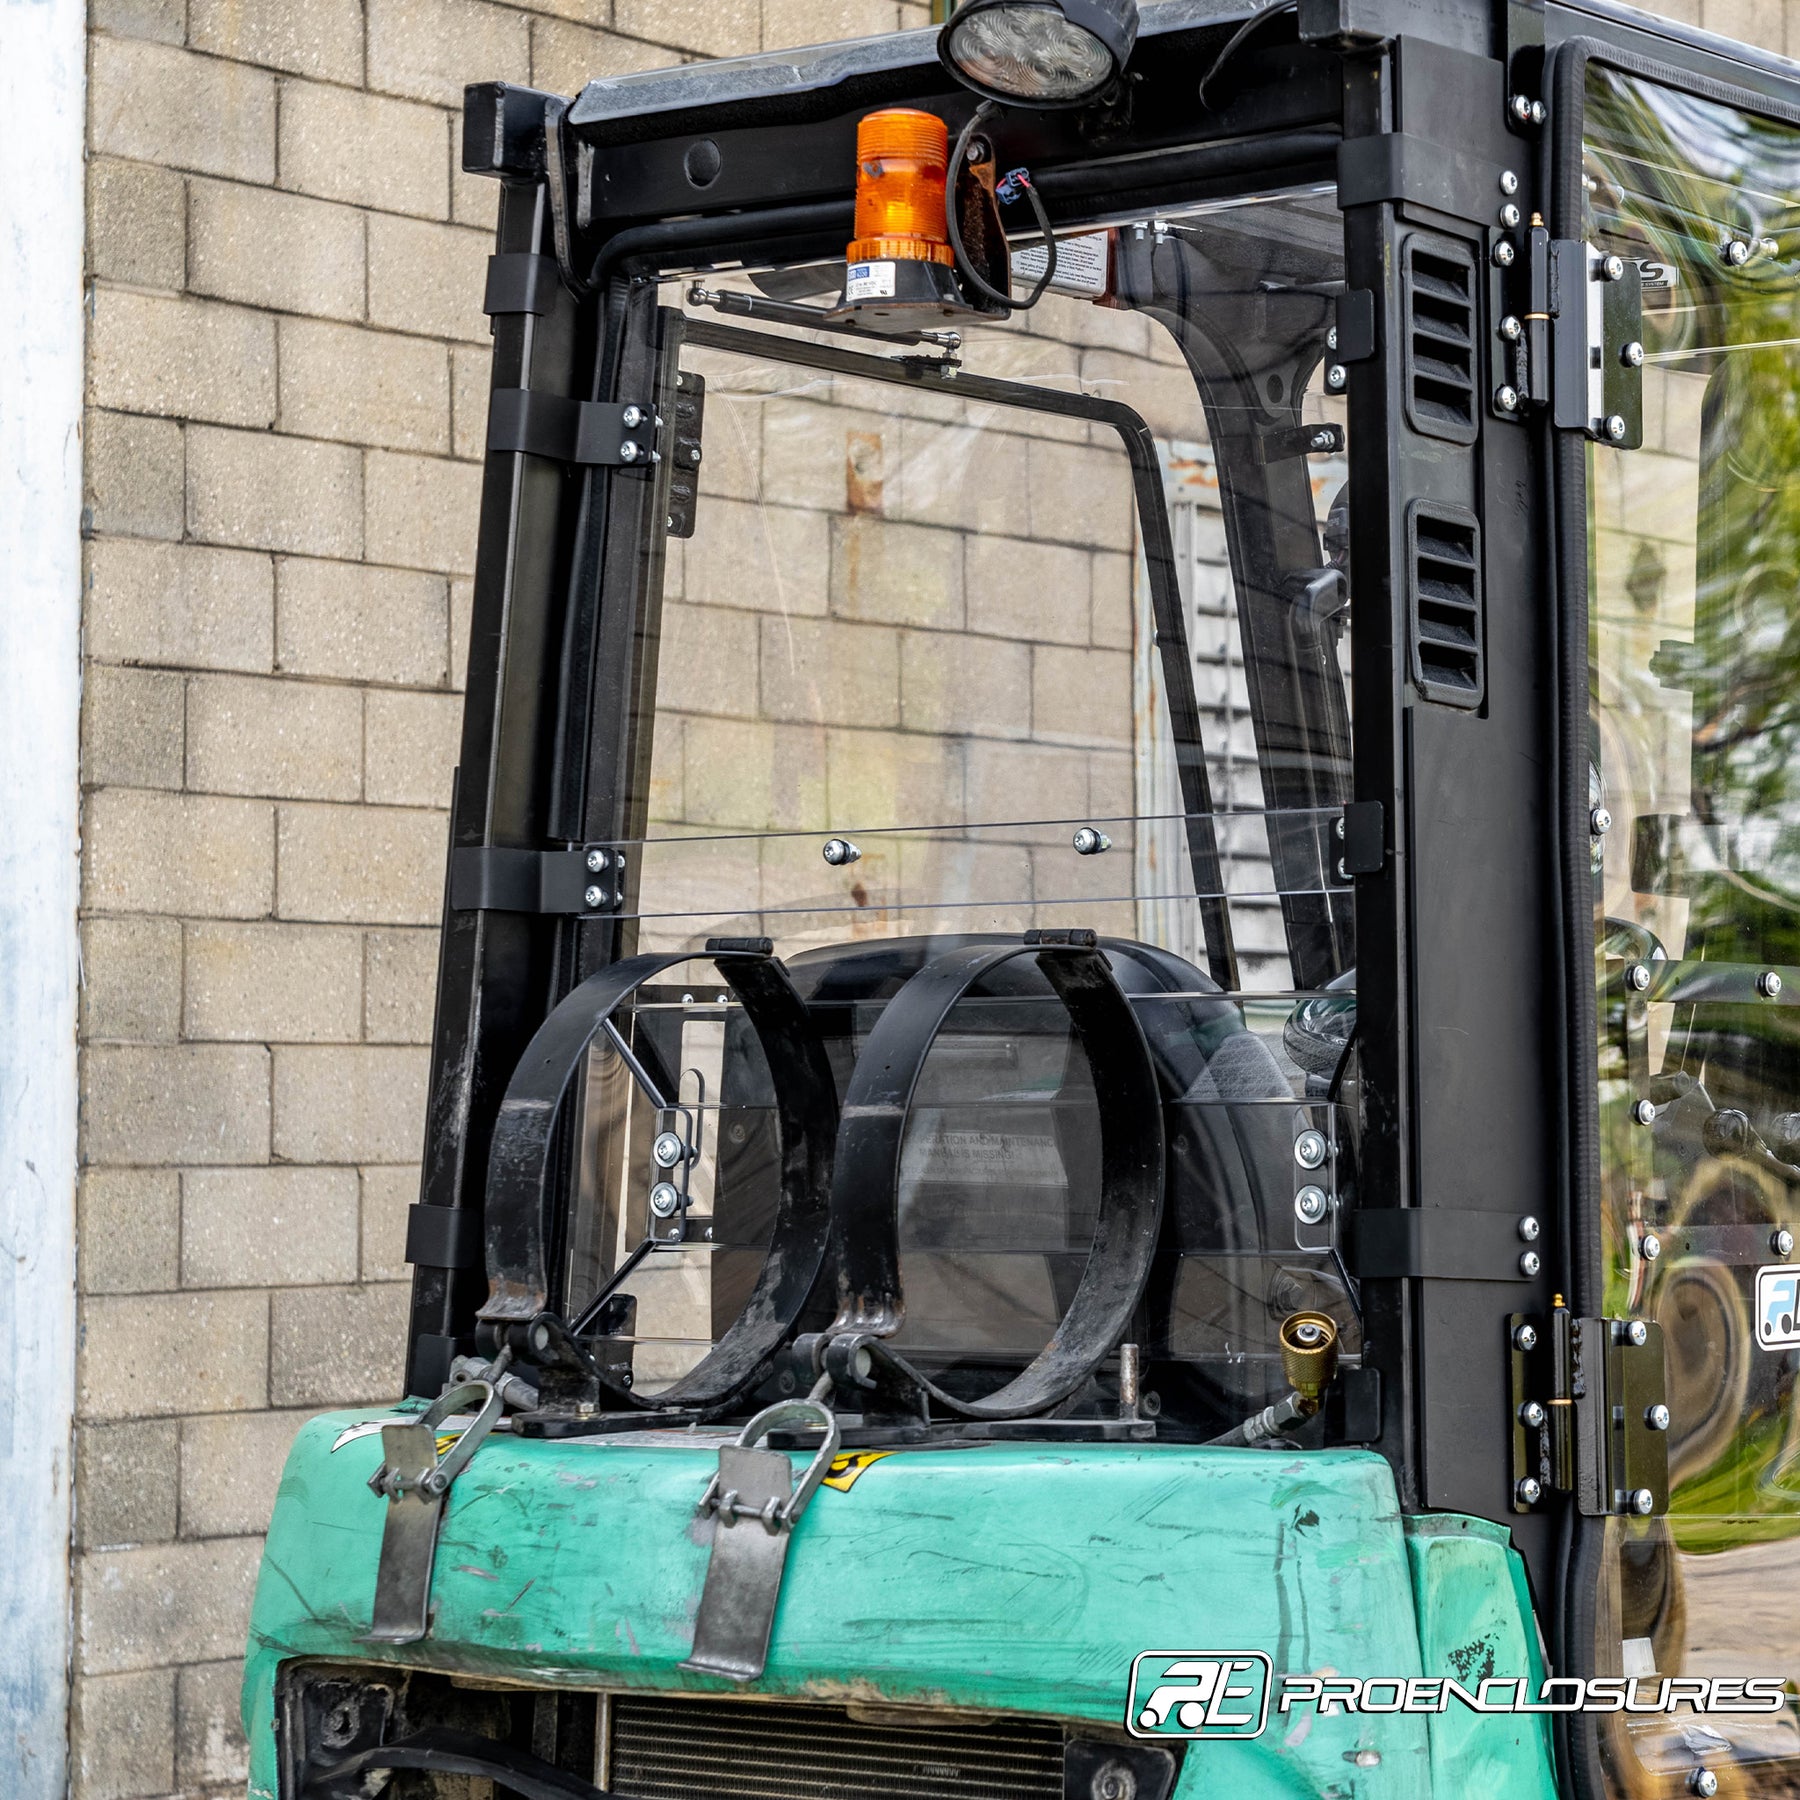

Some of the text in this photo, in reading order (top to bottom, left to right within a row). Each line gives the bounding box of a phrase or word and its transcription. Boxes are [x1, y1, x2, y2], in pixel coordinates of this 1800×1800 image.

[1639, 260, 1664, 281] S
[914, 1134, 967, 1146] PERATION
[991, 1134, 1055, 1148] MAINTENANC
